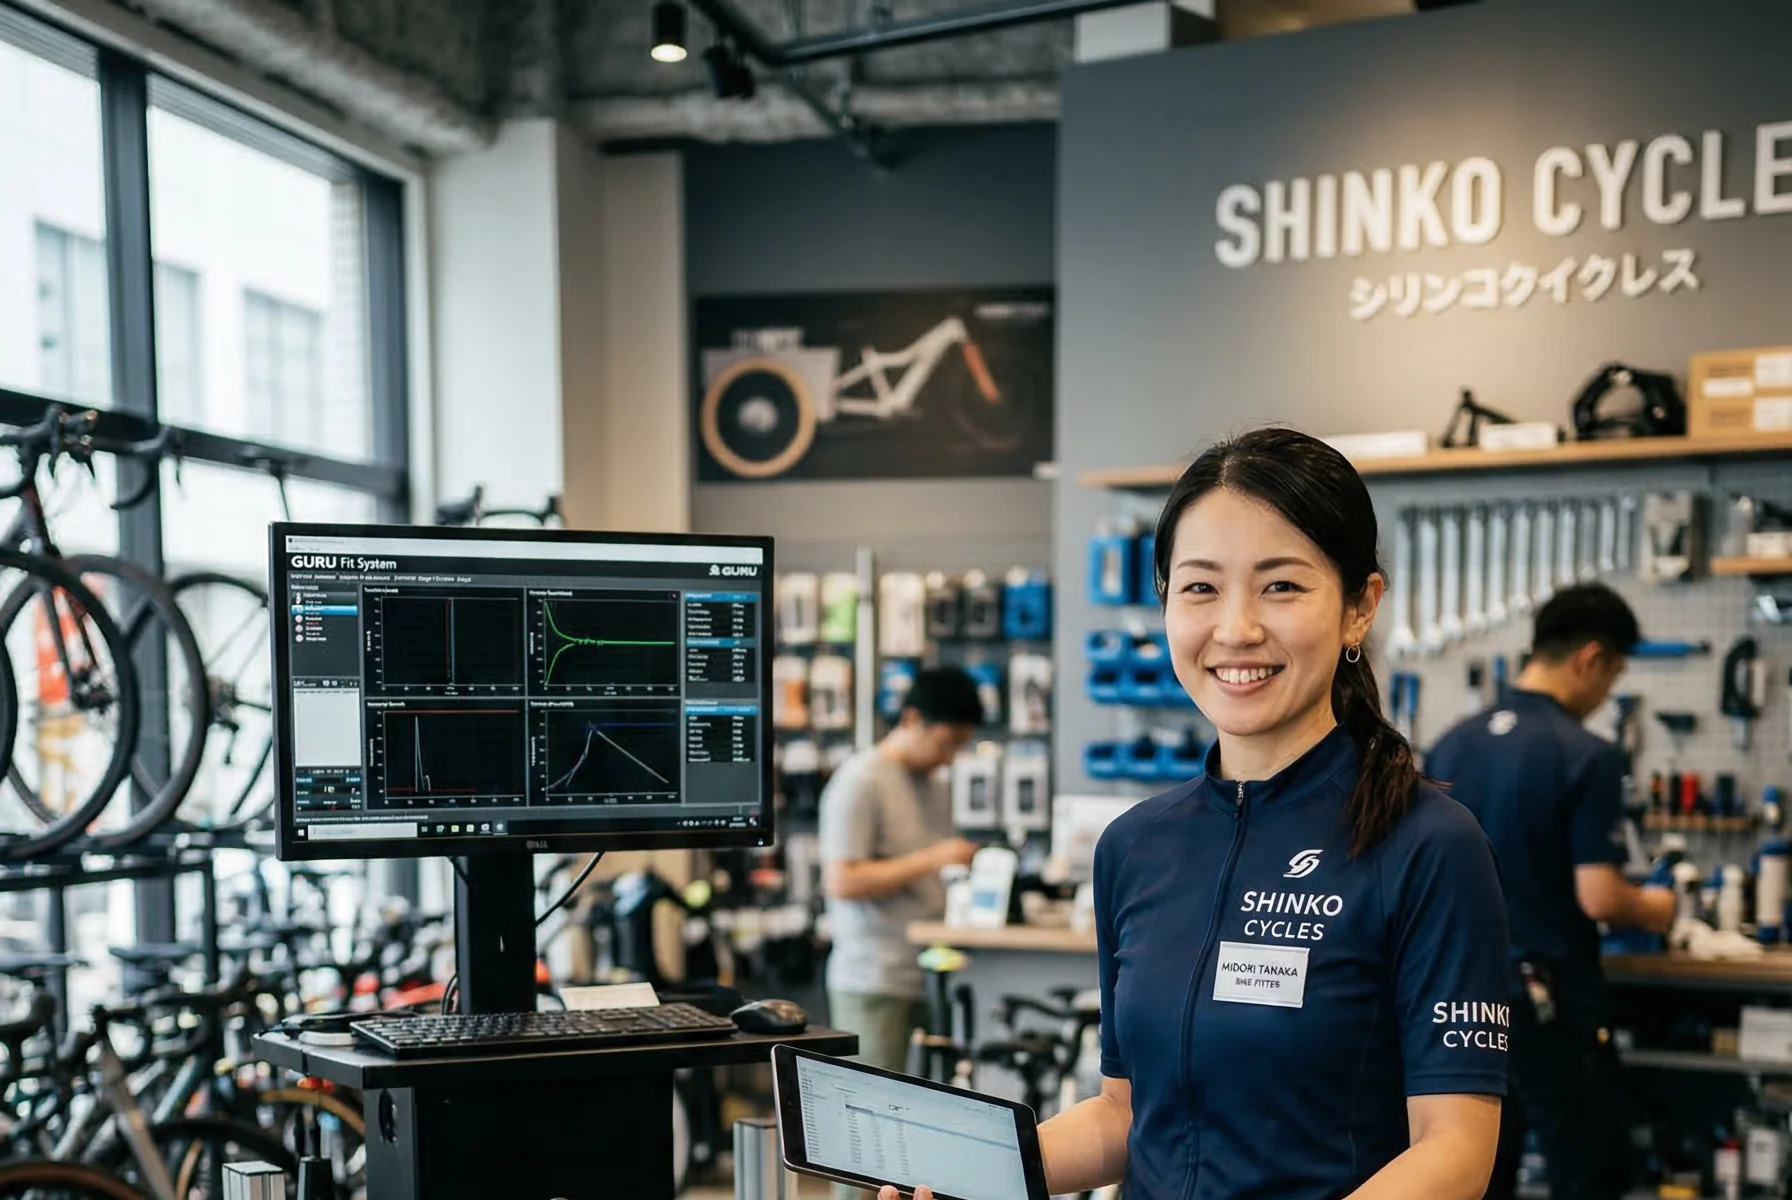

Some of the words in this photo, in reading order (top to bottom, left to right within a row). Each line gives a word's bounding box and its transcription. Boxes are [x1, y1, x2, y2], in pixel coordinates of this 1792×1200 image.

[1215, 156, 1502, 268] SHINKO
[1533, 121, 1792, 235] CYCLE
[291, 555, 337, 569] GURU
[340, 557, 355, 569] Fit
[357, 556, 397, 572] System
[1240, 890, 1344, 916] SHINKO
[1244, 919, 1325, 941] CYCLES
[1259, 964, 1298, 977] TANAKA
